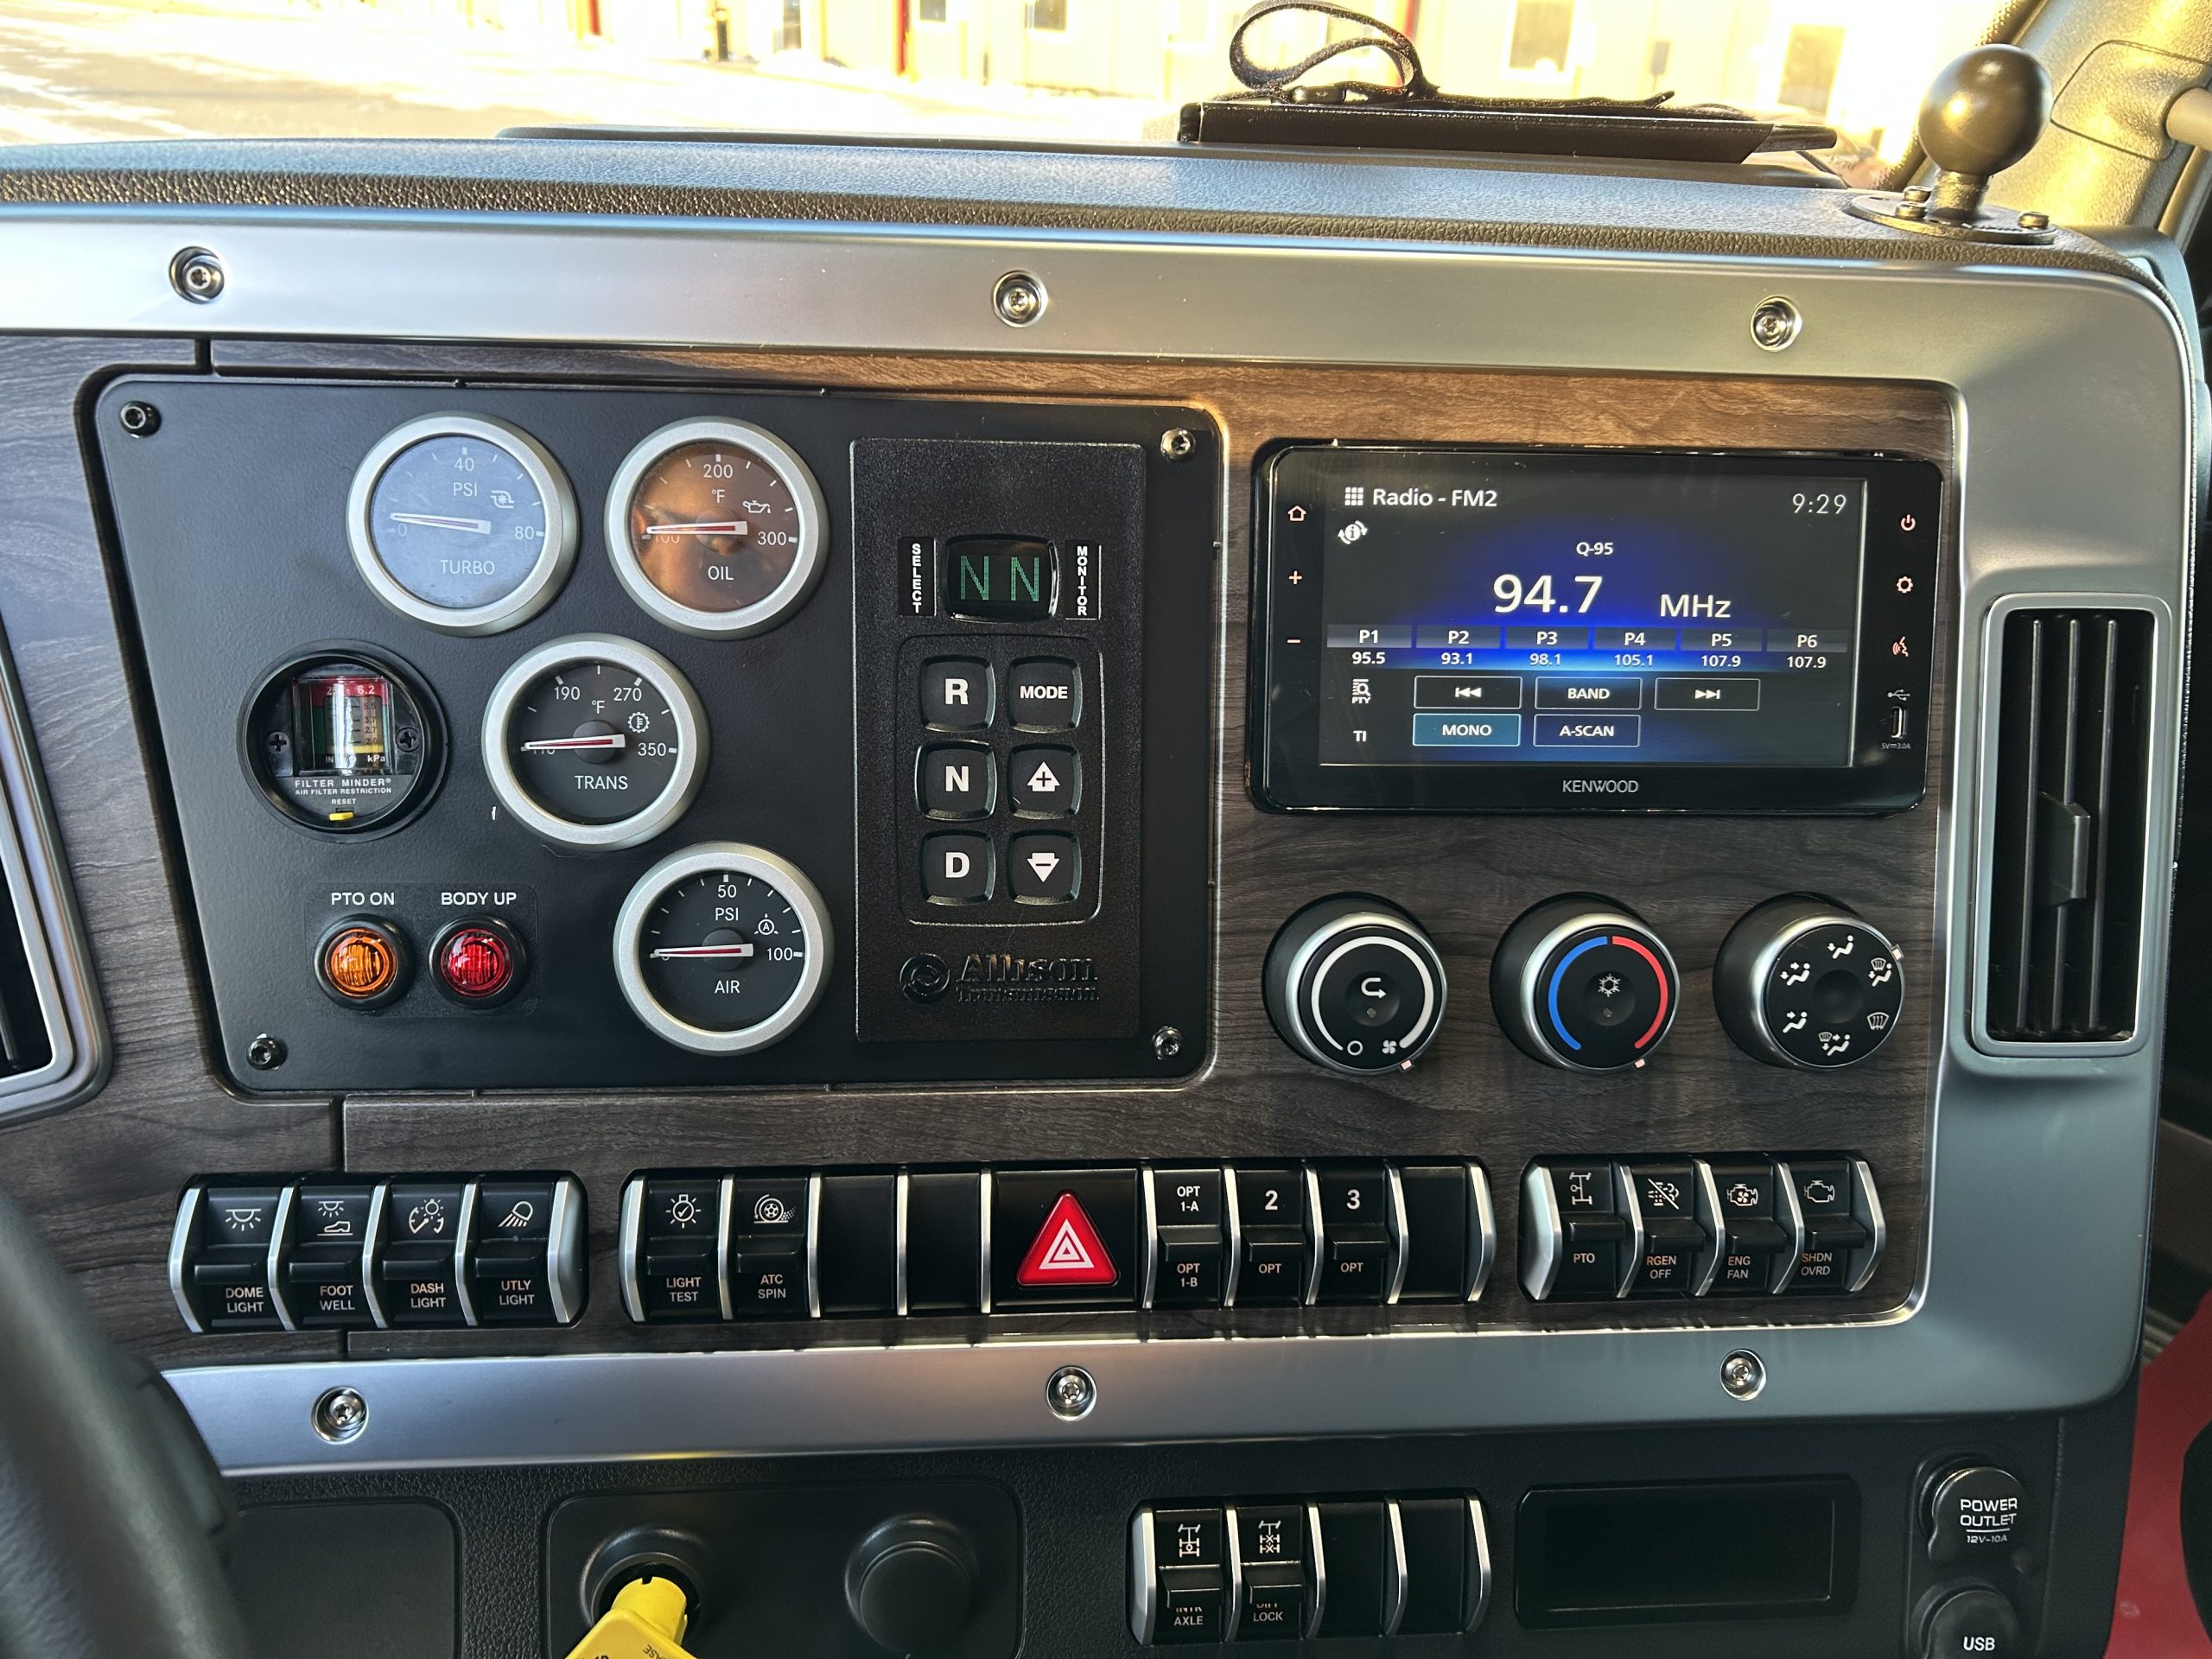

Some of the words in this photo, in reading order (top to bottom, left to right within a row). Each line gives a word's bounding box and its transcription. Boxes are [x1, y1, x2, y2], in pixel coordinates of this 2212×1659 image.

[454, 457, 474, 473] 40
[702, 464, 734, 479] 200
[453, 482, 478, 498] PSI
[1372, 488, 1433, 506] Radio
[1452, 489, 1497, 507] FM2
[1792, 493, 1847, 514] 9:29
[514, 526, 535, 541] 80
[757, 531, 788, 547] 300
[1575, 542, 1614, 557] Q-95
[440, 560, 496, 576] TURBO
[707, 565, 734, 582] OIL
[912, 543, 923, 613] SELECT
[960, 555, 989, 601] N
[1010, 556, 1039, 602] N
[1077, 545, 1088, 616] MONITOR
[1492, 574, 1604, 613] 94.7
[1659, 594, 1732, 618] MHz
[1358, 629, 1379, 644] P1
[1447, 630, 1470, 645] P2
[1535, 631, 1558, 645] P3
[1624, 632, 1646, 646] P4
[1711, 633, 1732, 647] P5
[1796, 634, 1818, 648] P6
[1351, 652, 1386, 665] 95.5
[1440, 652, 1472, 665] 93.1
[1529, 653, 1560, 666] 98.1
[1614, 654, 1654, 667] 105.1
[1700, 655, 1741, 668] 107.9
[1786, 656, 1827, 669] 107.9
[357, 685, 376, 695] 6.2
[554, 686, 581, 702] 190
[613, 687, 642, 702] 270
[944, 679, 969, 705] R
[1020, 685, 1068, 700] MODE
[1567, 687, 1611, 701] BAND
[364, 702, 377, 711] 5.5
[365, 716, 378, 725] 3.7
[365, 726, 378, 734] 2.7
[1353, 730, 1367, 742] TI
[1442, 724, 1492, 736] MONO
[1559, 725, 1615, 738] A-SCAN
[638, 742, 667, 757] 350
[367, 754, 386, 763] kPa
[295, 779, 334, 788] FILTER
[575, 775, 629, 790] TRANS
[946, 766, 969, 791] N
[340, 786, 392, 795] RESTRICTION
[1562, 779, 1640, 794] KENWOOD
[946, 852, 969, 878] D
[716, 884, 738, 899] 50
[330, 892, 365, 906] PTO
[368, 892, 396, 906] ON
[440, 892, 489, 906] BODY
[493, 891, 517, 906] UP
[714, 906, 740, 921] PSI
[766, 947, 793, 962] 100
[956, 953, 1099, 983] Allison
[714, 979, 741, 994] AIR
[1176, 1185, 1200, 1198] OPT
[1264, 1190, 1278, 1211] 2
[1346, 1189, 1361, 1210] 3
[1180, 1201, 1199, 1212] 1-A
[1573, 1252, 1595, 1264] PTO
[1646, 1255, 1677, 1266] RGEN
[1727, 1255, 1751, 1267] ENG
[1802, 1252, 1833, 1263] SHDN
[1176, 1263, 1200, 1274] OPT
[1258, 1263, 1282, 1274] OPT
[1340, 1262, 1363, 1274] OPT
[1649, 1268, 1672, 1280] OFF
[1727, 1268, 1749, 1280] FAN
[1801, 1266, 1831, 1276] OVRD
[501, 1280, 531, 1292] UTLY
[666, 1277, 702, 1289] LIGHT
[760, 1274, 784, 1286] ATC
[1180, 1276, 1198, 1287] 1-B
[226, 1287, 264, 1299] DOME
[320, 1285, 353, 1296] FOOT
[410, 1283, 444, 1294] DASH
[758, 1287, 786, 1300] SPIN
[410, 1297, 447, 1309] LIGHT
[499, 1294, 535, 1306] LIGHT
[669, 1291, 699, 1303] TEST
[226, 1301, 264, 1313] LIGHT
[319, 1300, 355, 1312] WELL
[1960, 1497, 2018, 1512] POWER
[1960, 1513, 2017, 1527] OUTLET
[1967, 1535, 2008, 1543] 12V-10A
[1173, 1616, 1204, 1626] AXLE
[1253, 1611, 1284, 1622] LOCK
[1963, 1636, 1996, 1651] USB
